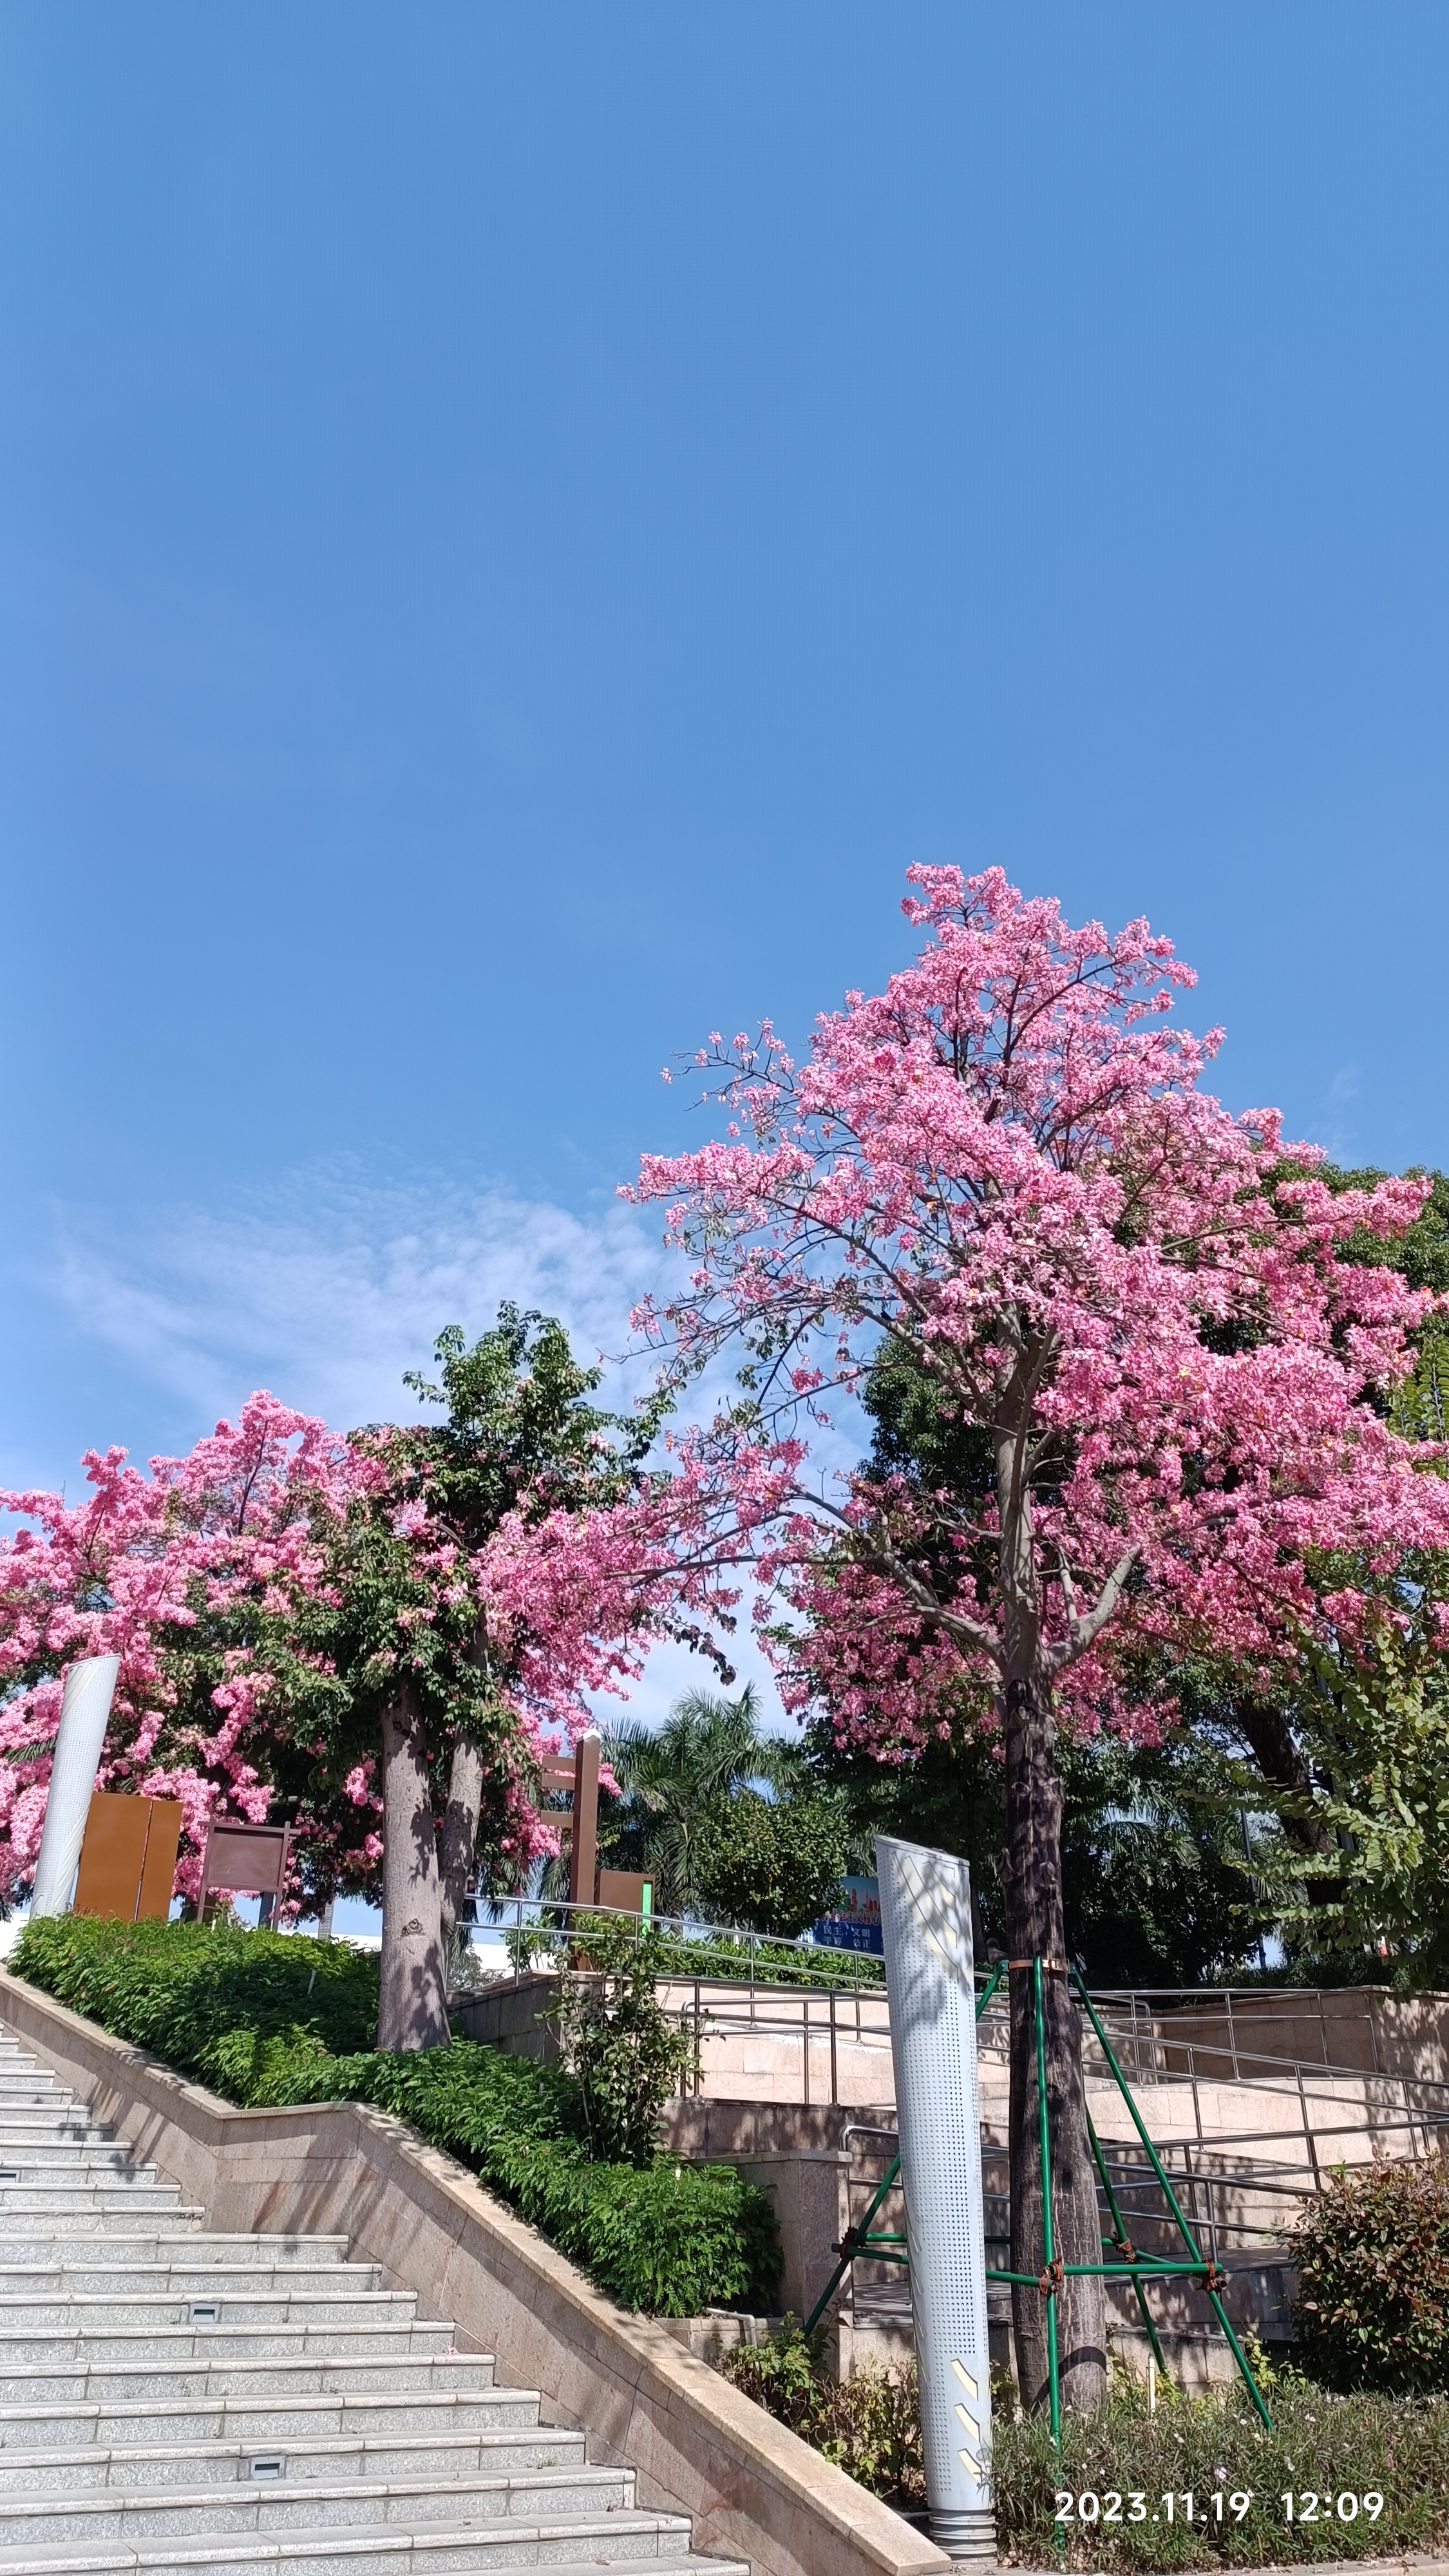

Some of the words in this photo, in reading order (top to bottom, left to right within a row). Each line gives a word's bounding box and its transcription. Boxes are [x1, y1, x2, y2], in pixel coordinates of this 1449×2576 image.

[824, 1925, 842, 1935] 民主
[853, 1928, 870, 1938] 文明
[853, 1938, 871, 1948] 公正
